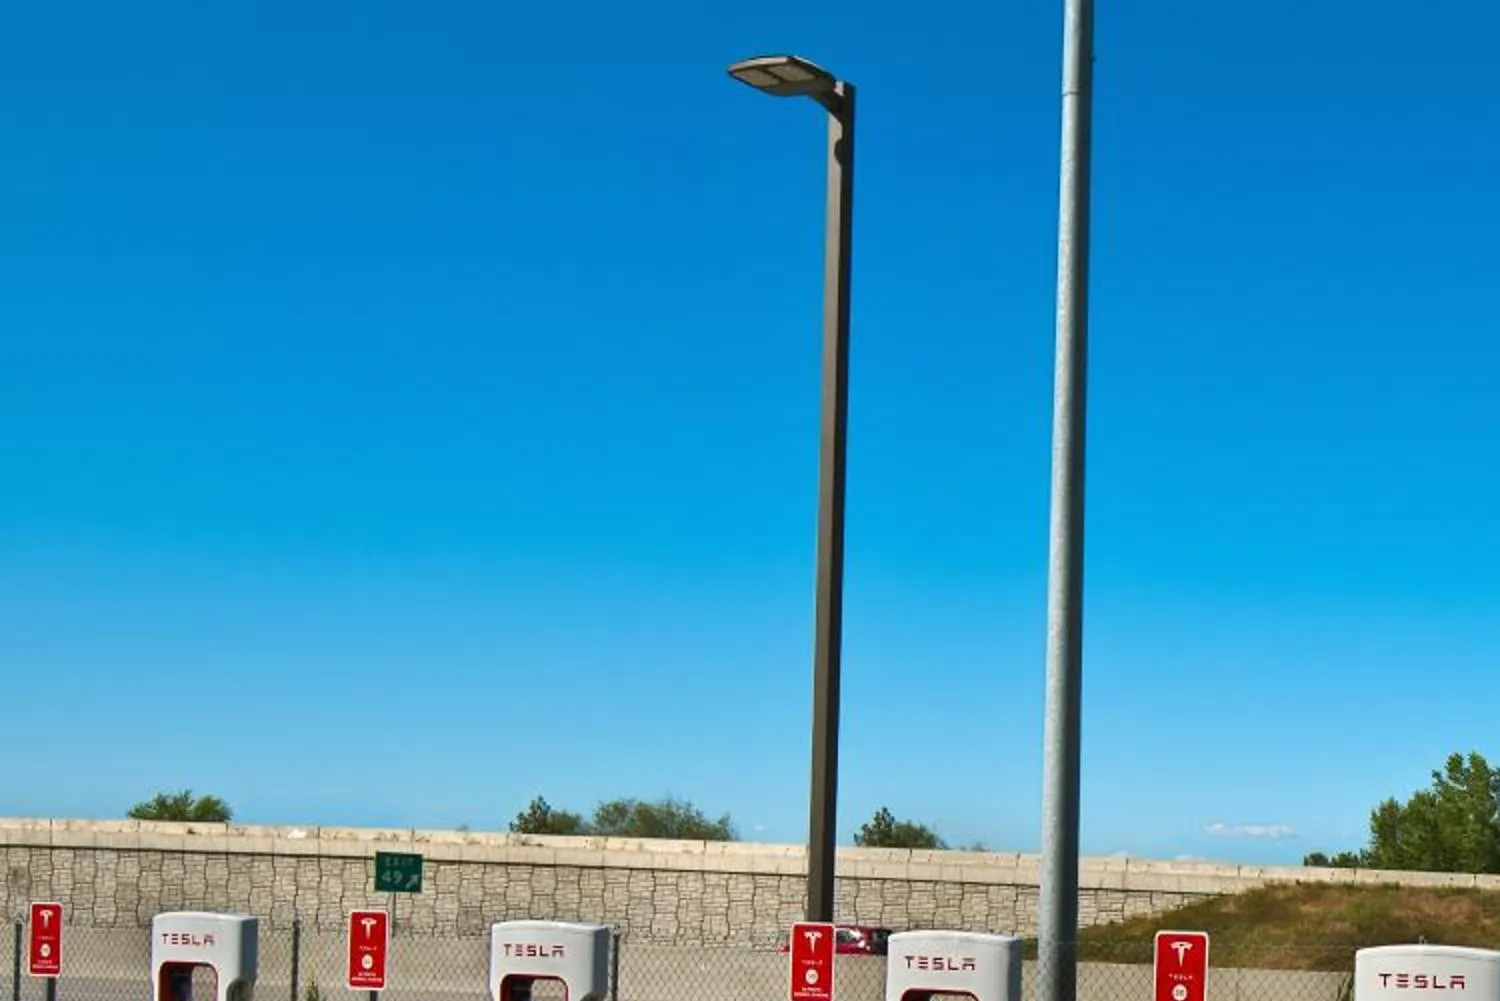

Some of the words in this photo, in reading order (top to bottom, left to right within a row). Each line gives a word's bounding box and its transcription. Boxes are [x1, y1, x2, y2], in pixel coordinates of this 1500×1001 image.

[381, 869, 403, 884] 49
[161, 933, 215, 946] TESLA
[503, 943, 564, 957] TESLA
[904, 955, 976, 971] TESLA
[1378, 973, 1465, 989] TESLA
